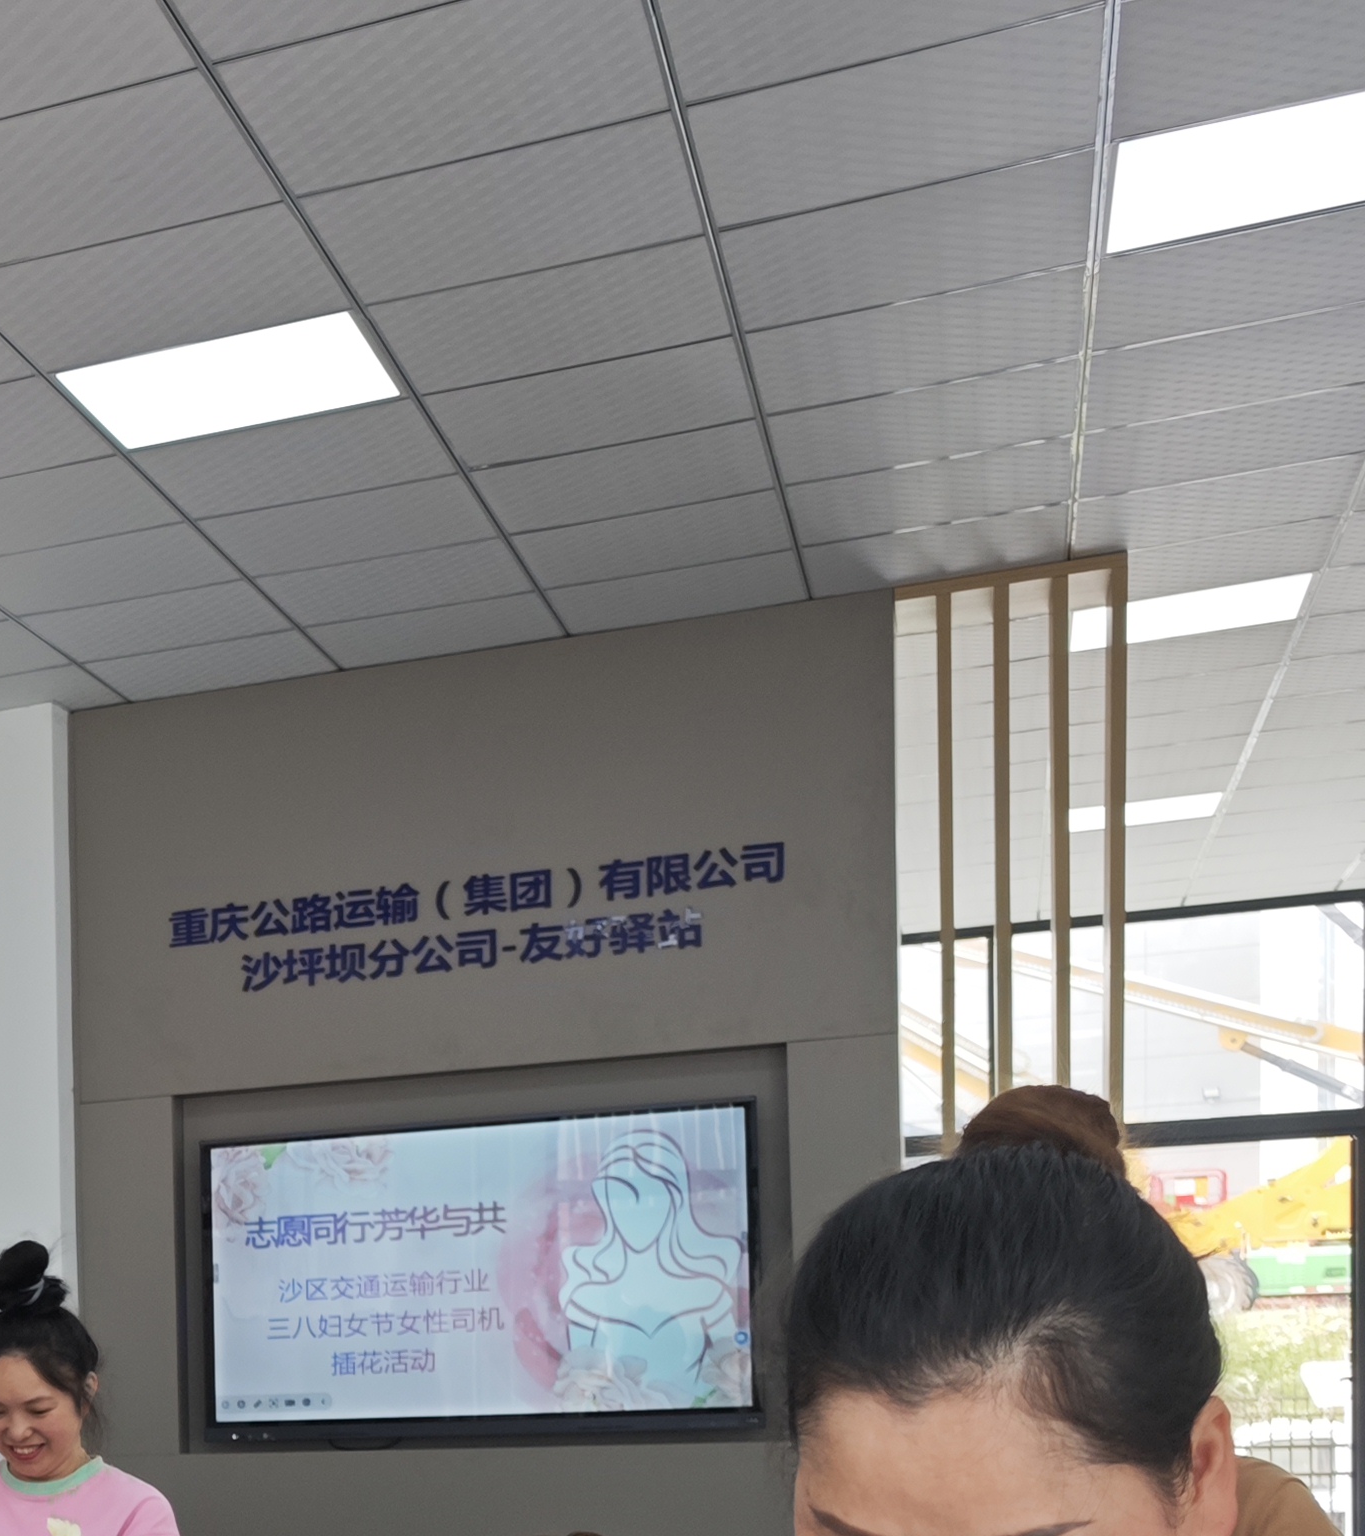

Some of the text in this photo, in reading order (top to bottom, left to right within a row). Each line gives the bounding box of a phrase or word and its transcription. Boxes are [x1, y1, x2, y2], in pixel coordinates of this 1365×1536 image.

[168, 842, 785, 949] 重庆公路运输（集团）有限公司
[240, 906, 703, 993] 沙坪坝分公司-友好驿站
[244, 1200, 507, 1249] 志愿同行芳华与共
[278, 1267, 492, 1303] 沙区交通运输行业
[267, 1305, 506, 1340] 三八妇女节女性司机
[330, 1347, 436, 1377] 插花活动
